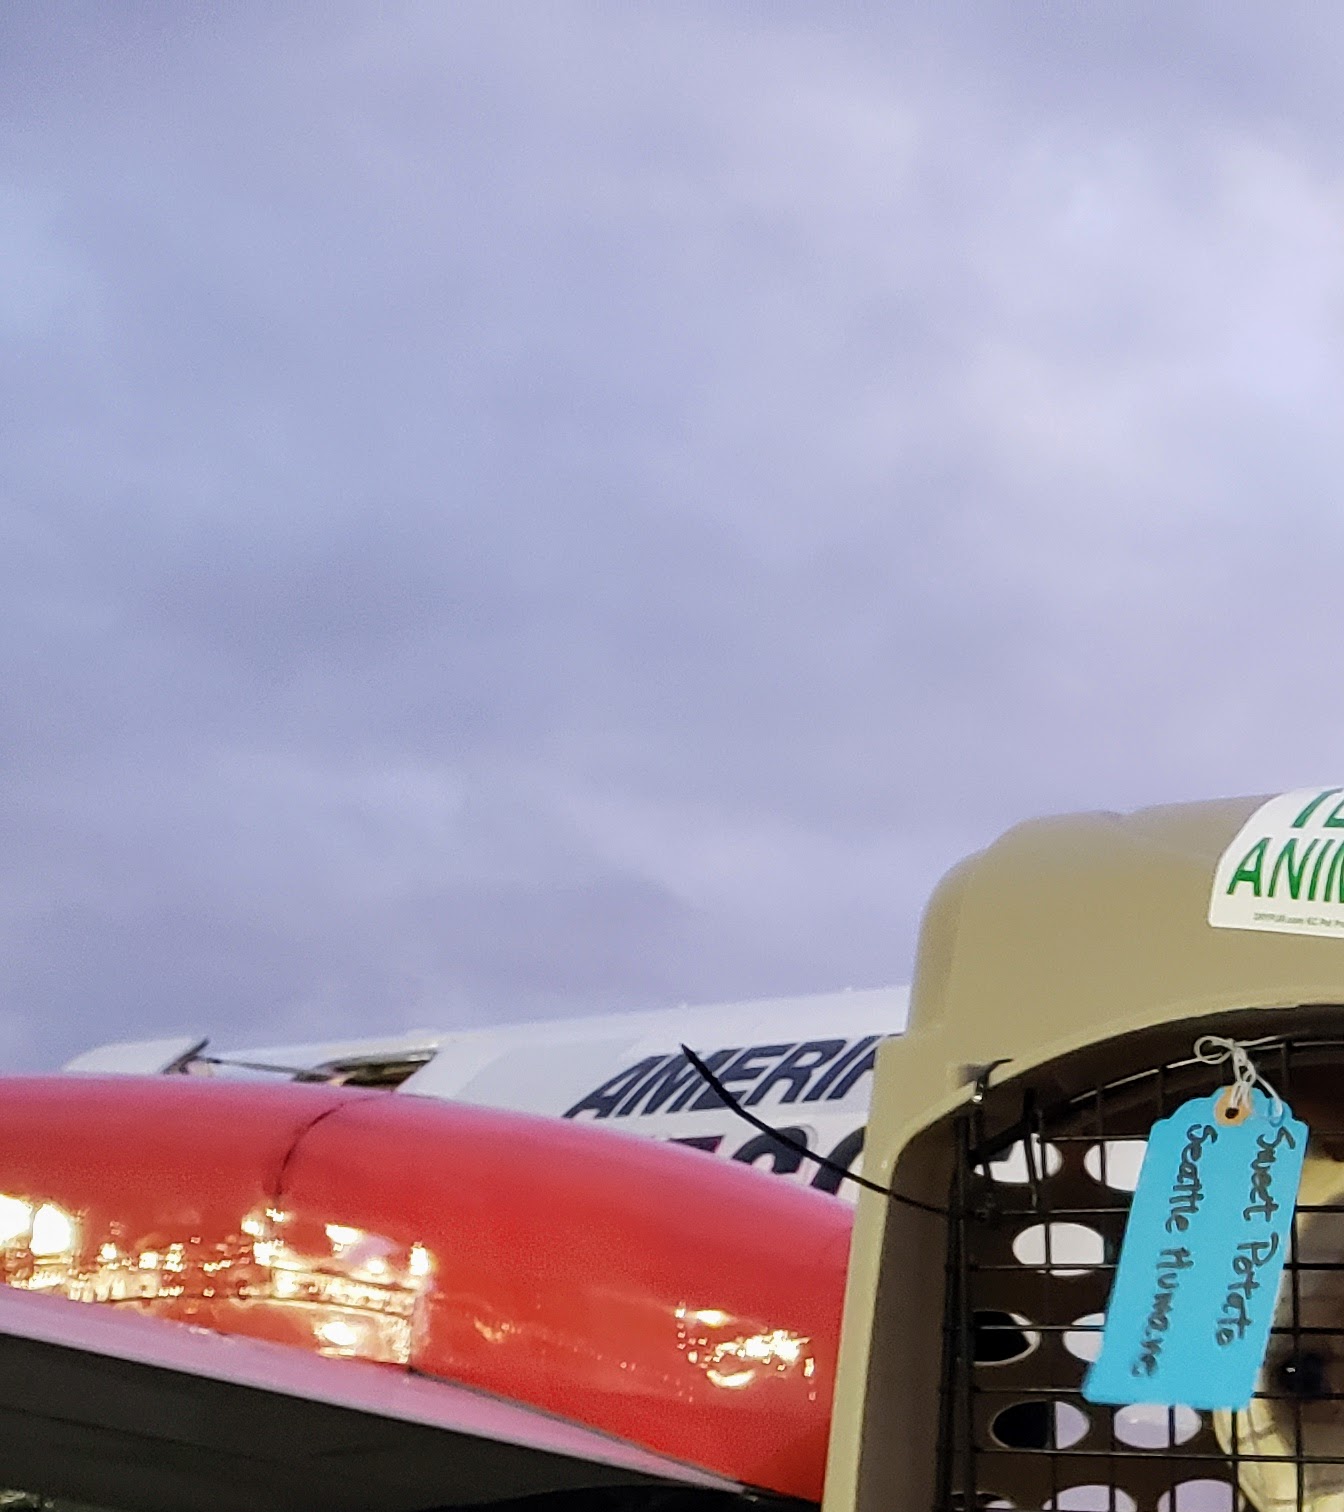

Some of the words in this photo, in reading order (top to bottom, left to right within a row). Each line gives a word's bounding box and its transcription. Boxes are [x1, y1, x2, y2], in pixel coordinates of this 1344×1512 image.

[1164, 1122, 1219, 1234] Seattle
[1242, 1125, 1296, 1223] Sweet
[1215, 1232, 1279, 1347] Potato
